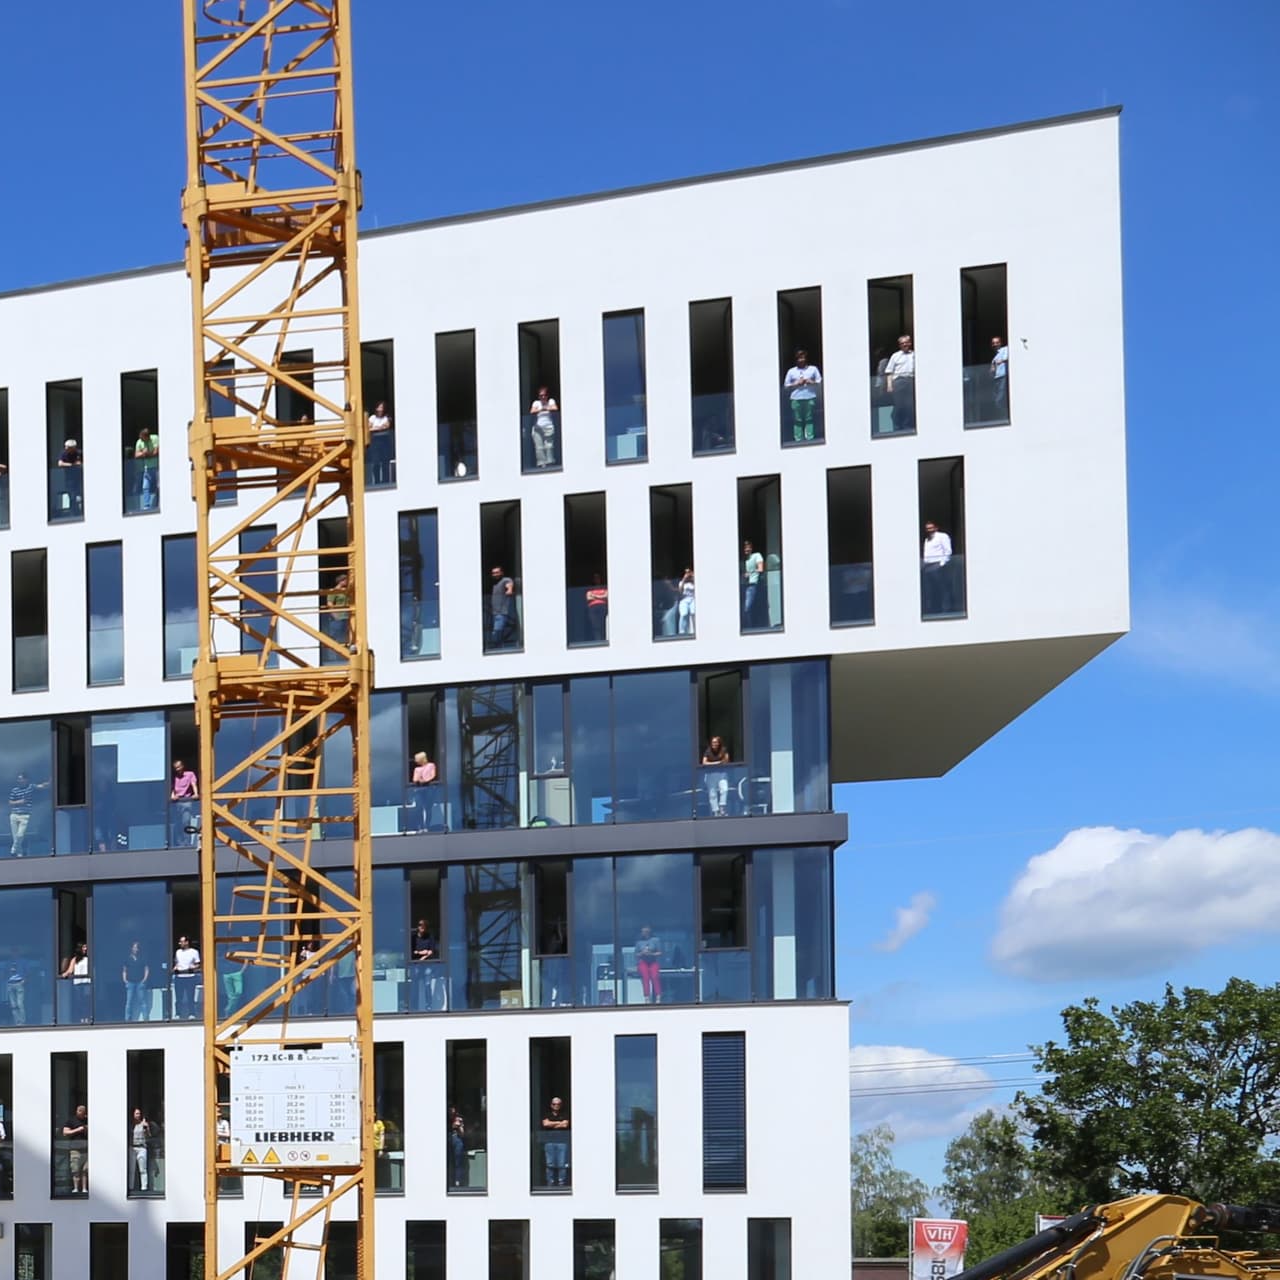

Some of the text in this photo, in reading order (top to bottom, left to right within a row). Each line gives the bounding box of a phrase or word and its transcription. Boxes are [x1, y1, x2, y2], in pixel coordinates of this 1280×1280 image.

[251, 1054, 269, 1062] 172
[255, 1131, 335, 1142] LIEBHERR
[926, 1227, 954, 1240] VTH
